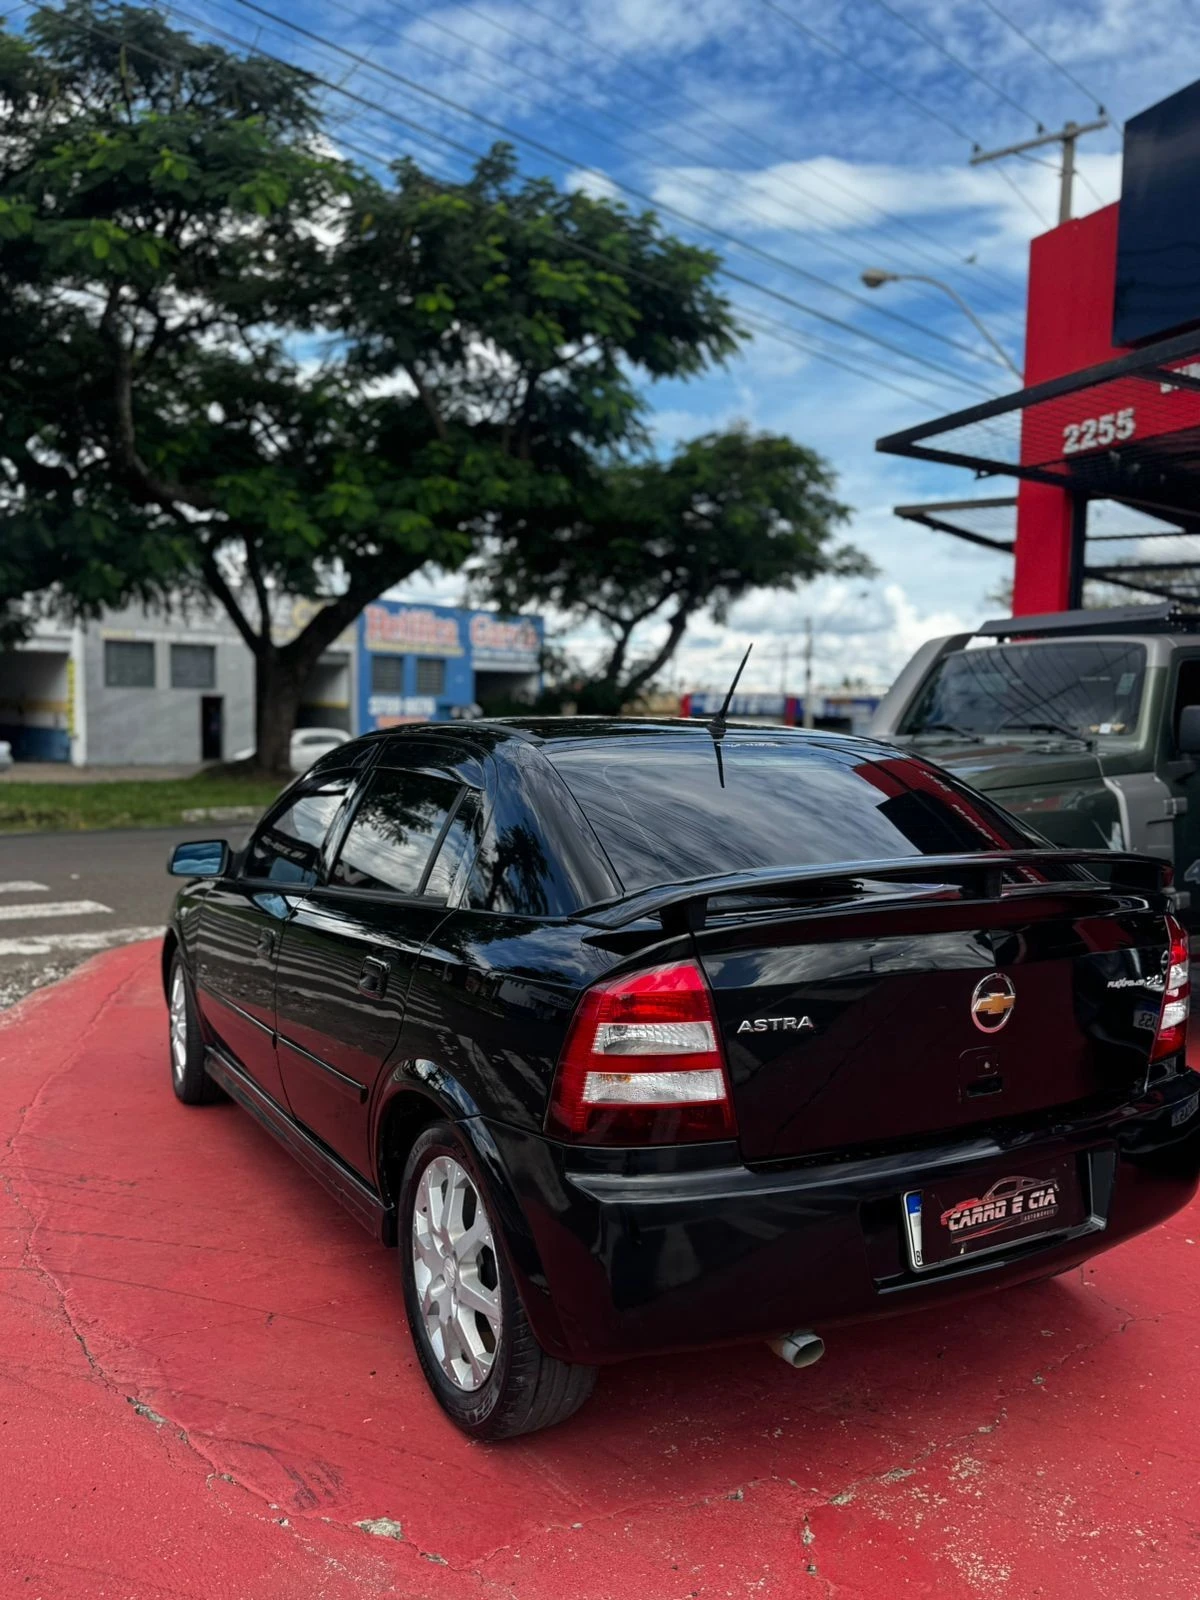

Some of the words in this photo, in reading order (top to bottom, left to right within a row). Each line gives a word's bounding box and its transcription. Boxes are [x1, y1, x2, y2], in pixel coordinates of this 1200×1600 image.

[1063, 408, 1136, 454] 2255
[737, 1016, 814, 1034] ASTRA
[949, 1199, 1007, 1231] CARRO
[1012, 1195, 1024, 1214] E
[1028, 1187, 1057, 1210] CIA
